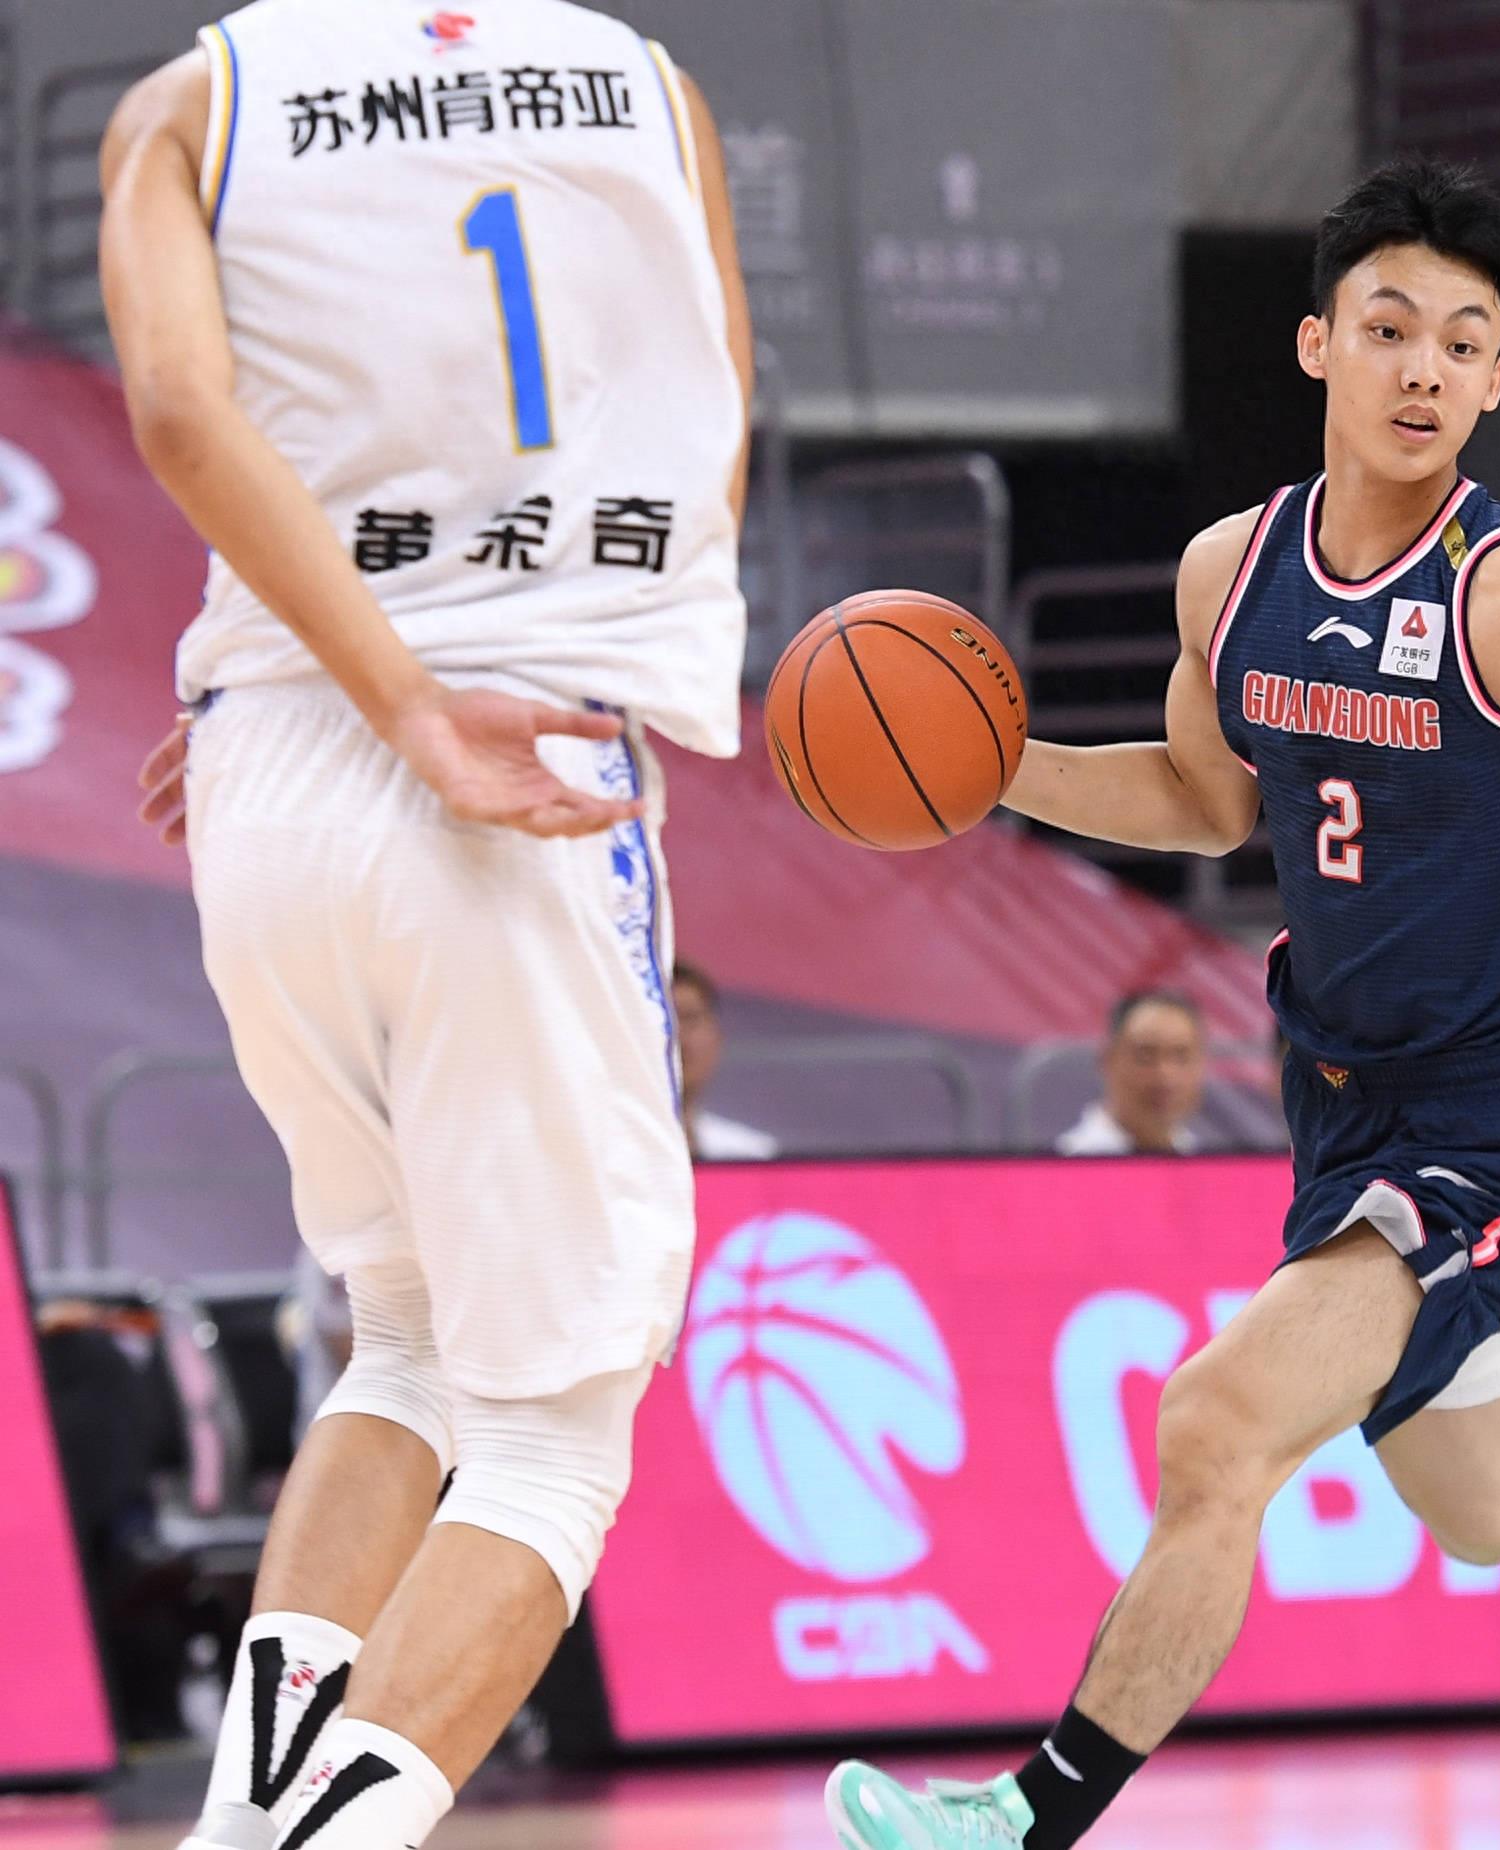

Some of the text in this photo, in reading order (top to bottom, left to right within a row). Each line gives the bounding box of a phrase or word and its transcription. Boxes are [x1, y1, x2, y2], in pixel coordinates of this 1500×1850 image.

[282, 66, 637, 157] 苏州肯帝亚
[457, 184, 556, 454] 1
[1243, 672, 1441, 750] GUANGDONG
[1396, 661, 1418, 674] CGB
[1317, 778, 1363, 884] 2
[773, 1594, 988, 1681] CBA
